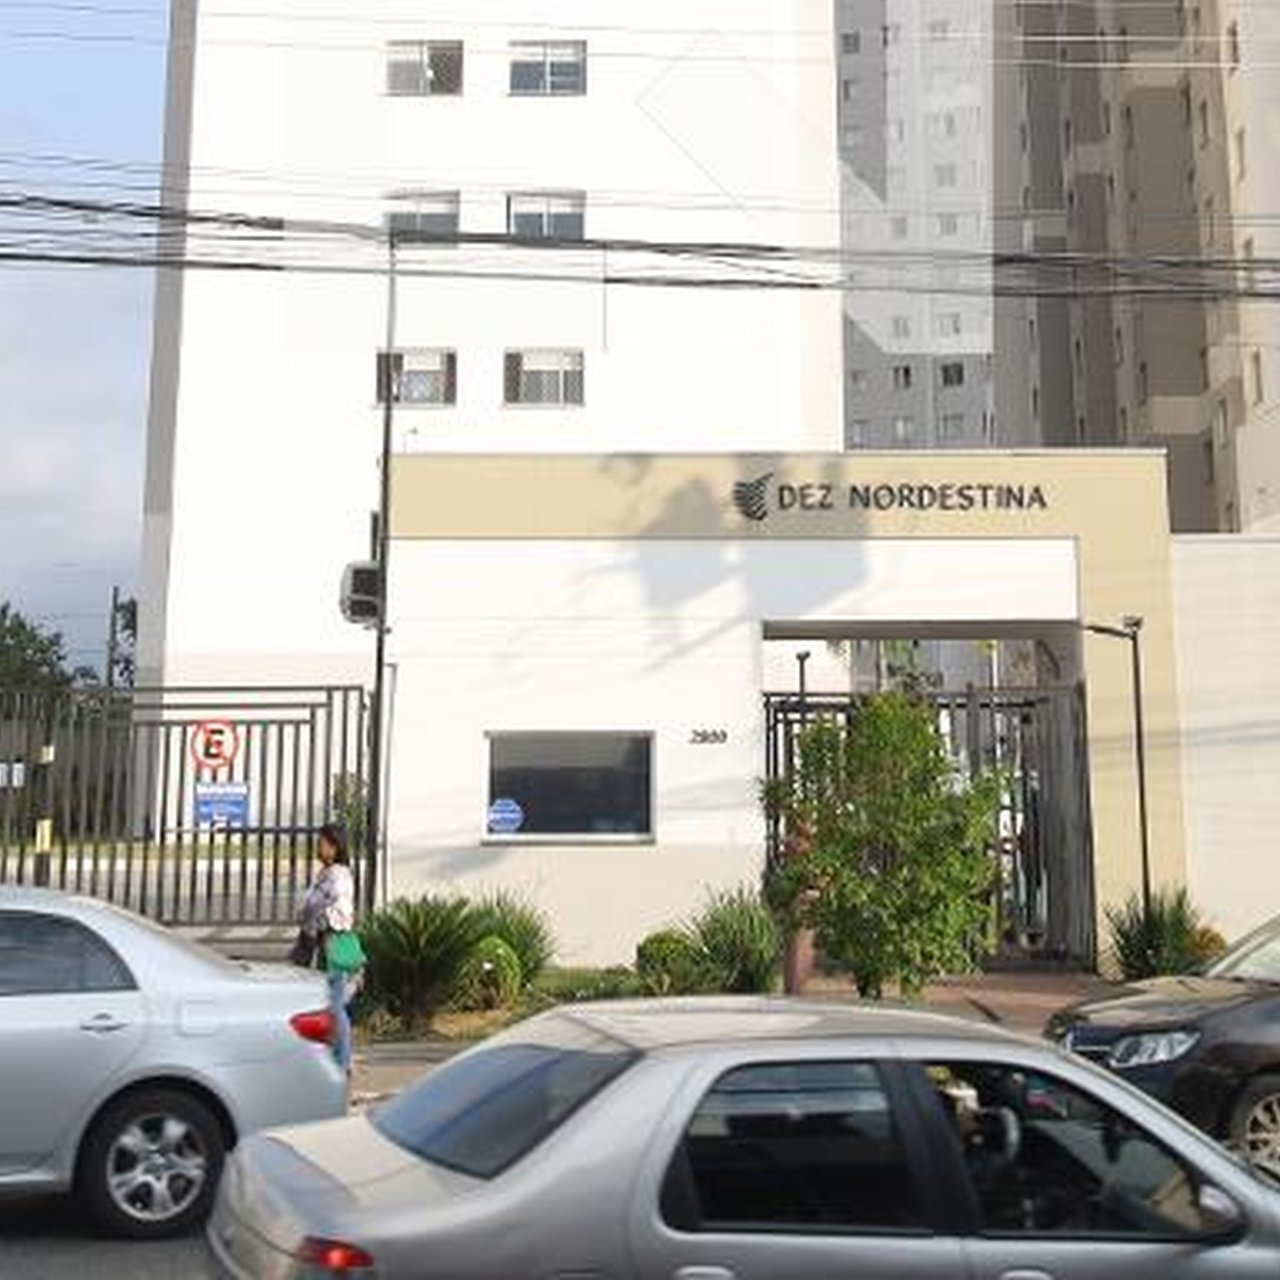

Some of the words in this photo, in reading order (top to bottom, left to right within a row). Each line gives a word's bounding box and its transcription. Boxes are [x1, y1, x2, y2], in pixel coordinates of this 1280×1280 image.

[777, 484, 833, 510] DEZ
[849, 484, 1047, 510] NORDESTINA
[203, 728, 225, 759] E
